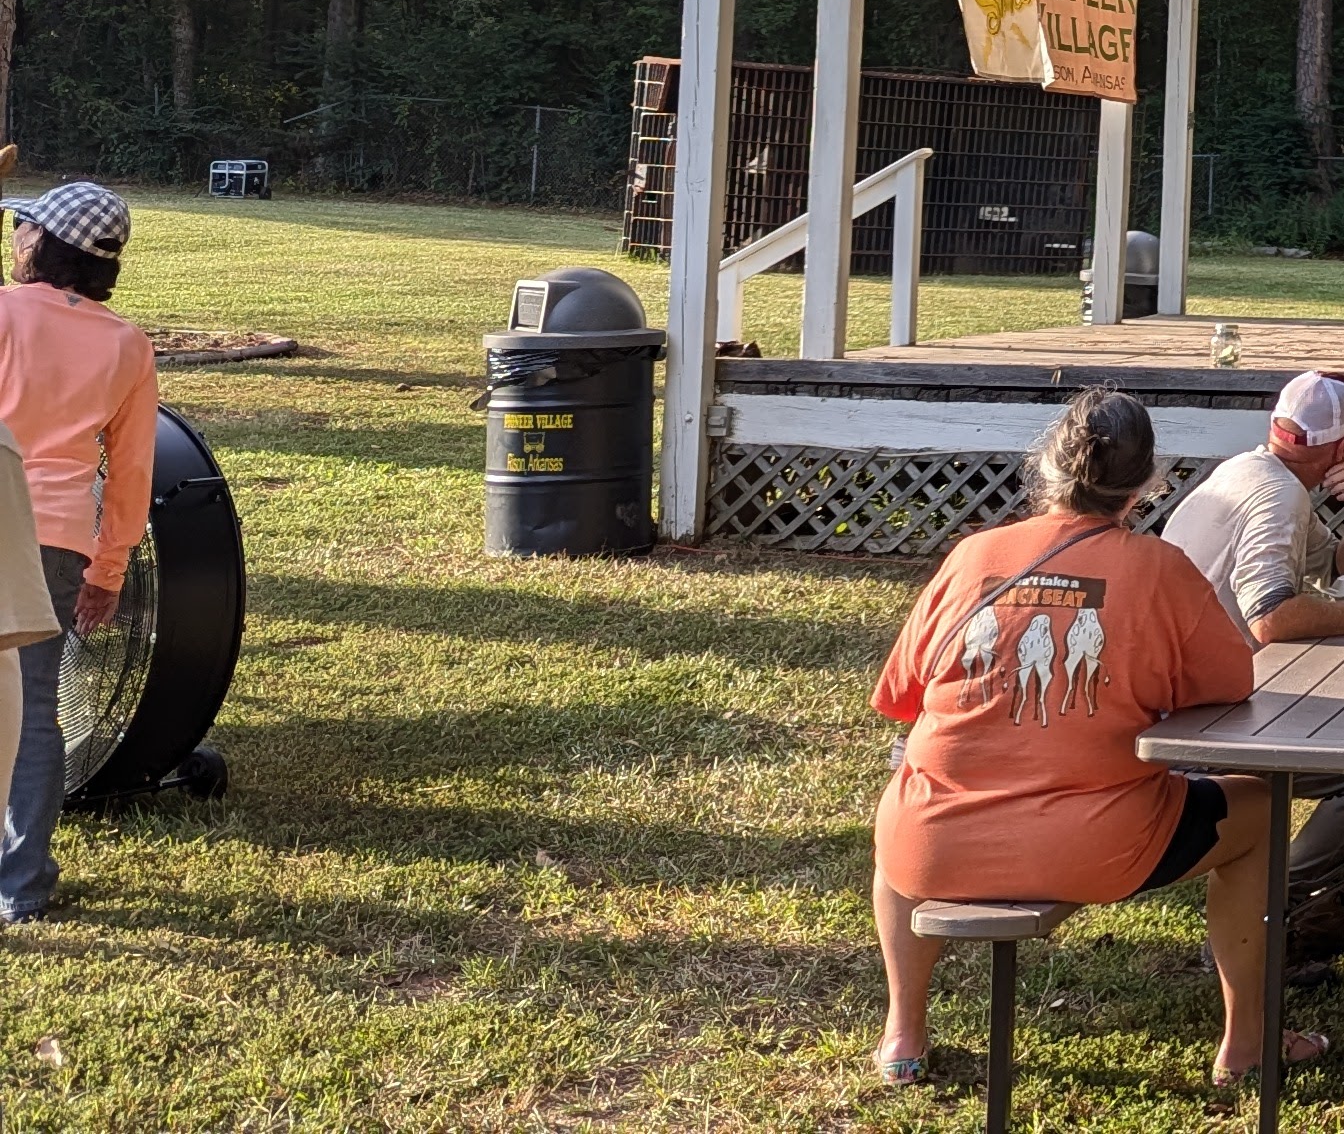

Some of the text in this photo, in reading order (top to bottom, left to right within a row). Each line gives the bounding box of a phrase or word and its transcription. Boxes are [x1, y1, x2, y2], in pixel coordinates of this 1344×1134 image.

[1053, 65, 1079, 85] SON,
[536, 414, 574, 429] VILLAGE
[528, 454, 563, 471] Arkansas
[1015, 575, 1080, 589] n't take a
[1041, 588, 1088, 608] SEAT
